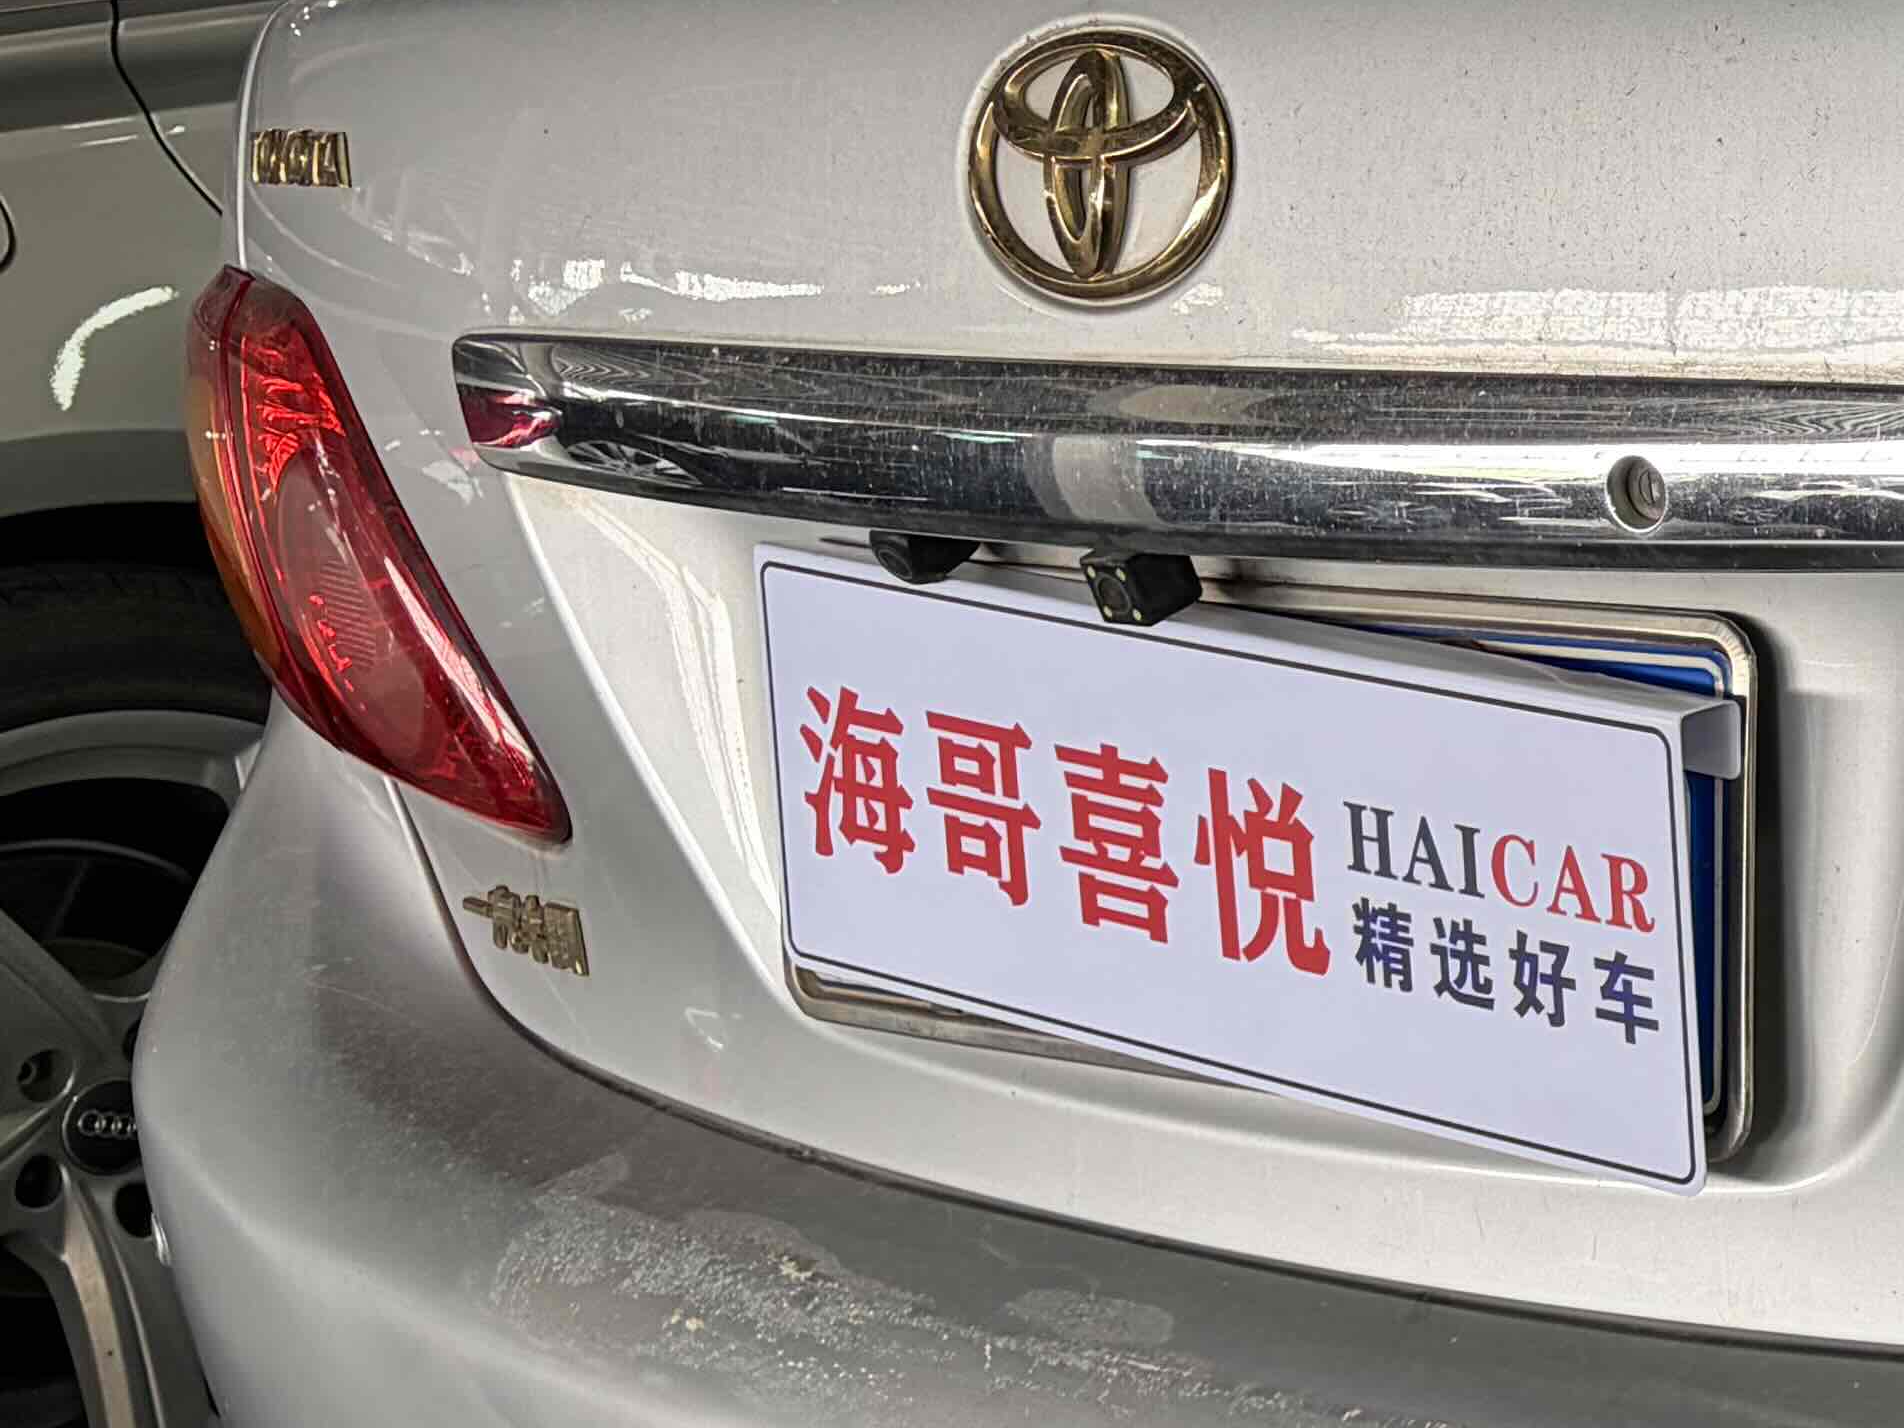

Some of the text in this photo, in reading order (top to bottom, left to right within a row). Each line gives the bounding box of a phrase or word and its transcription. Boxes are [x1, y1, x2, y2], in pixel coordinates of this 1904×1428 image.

[801, 684, 1332, 977] 海哥喜悦
[1342, 800, 1656, 934] HAICAR
[1352, 898, 1660, 1046] 精选好车
